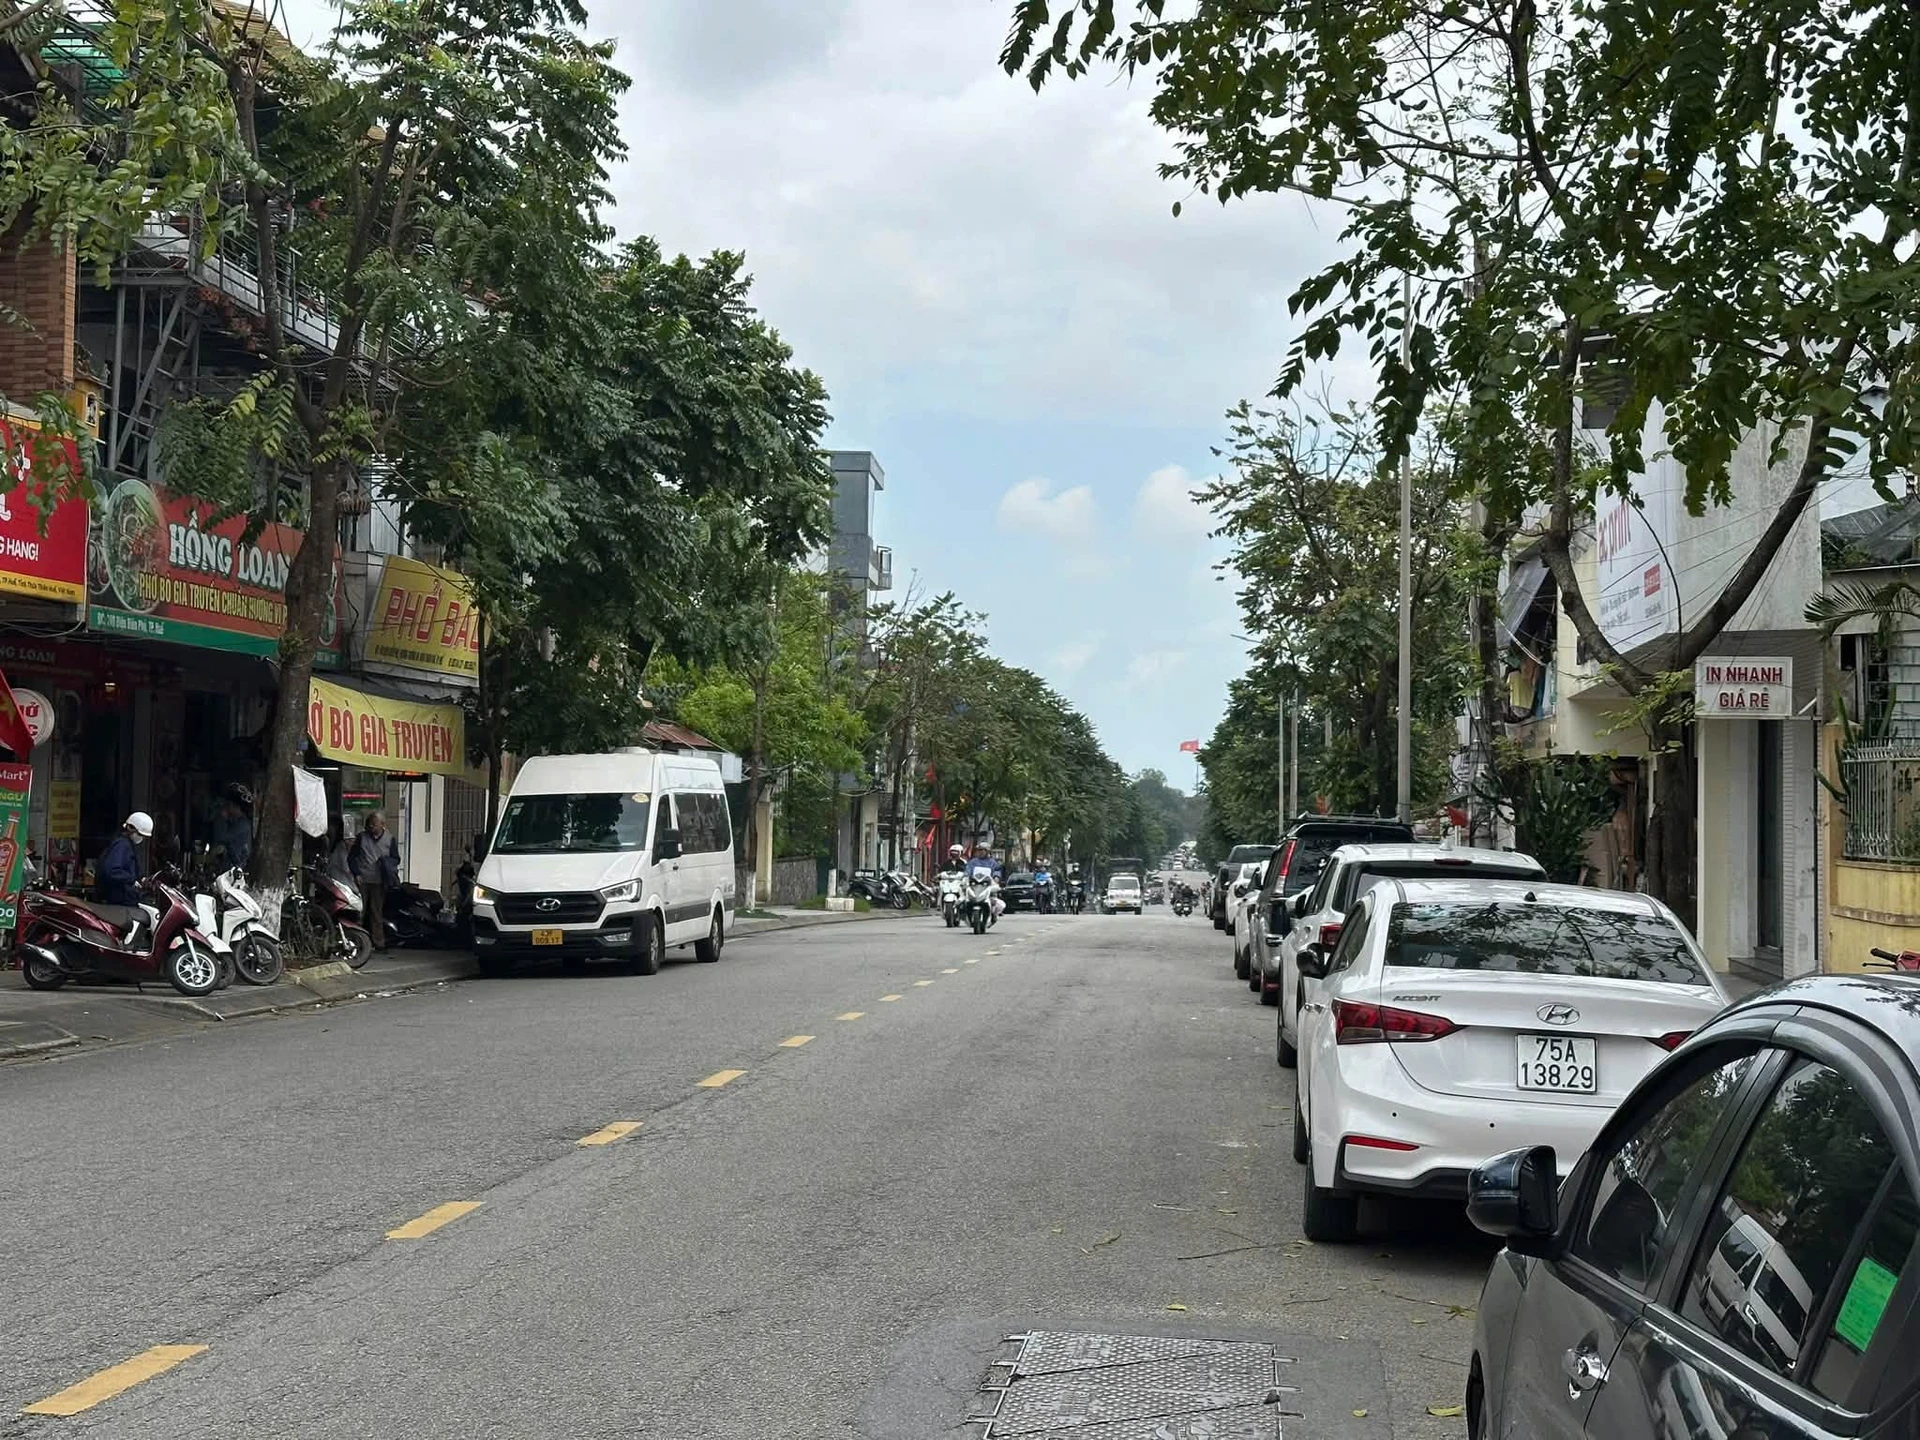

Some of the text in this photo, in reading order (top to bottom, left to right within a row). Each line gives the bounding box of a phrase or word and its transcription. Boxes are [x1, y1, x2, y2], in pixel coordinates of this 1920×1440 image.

[6, 537, 39, 562] HẠNG!
[169, 509, 290, 590] HỒNG LOAN
[139, 566, 158, 600] PHỞ
[159, 571, 172, 603] BÒ
[173, 579, 188, 606] GIA
[382, 578, 442, 642] PHỞ
[1706, 666, 1783, 683] IN NHANH
[1719, 686, 1769, 708] GIÁ RẺ
[329, 699, 354, 751] BÒ
[359, 713, 389, 757] GIA
[391, 713, 453, 763] TRUYỀN
[1535, 1037, 1577, 1063] 75A
[1521, 1062, 1593, 1089] 138.29
